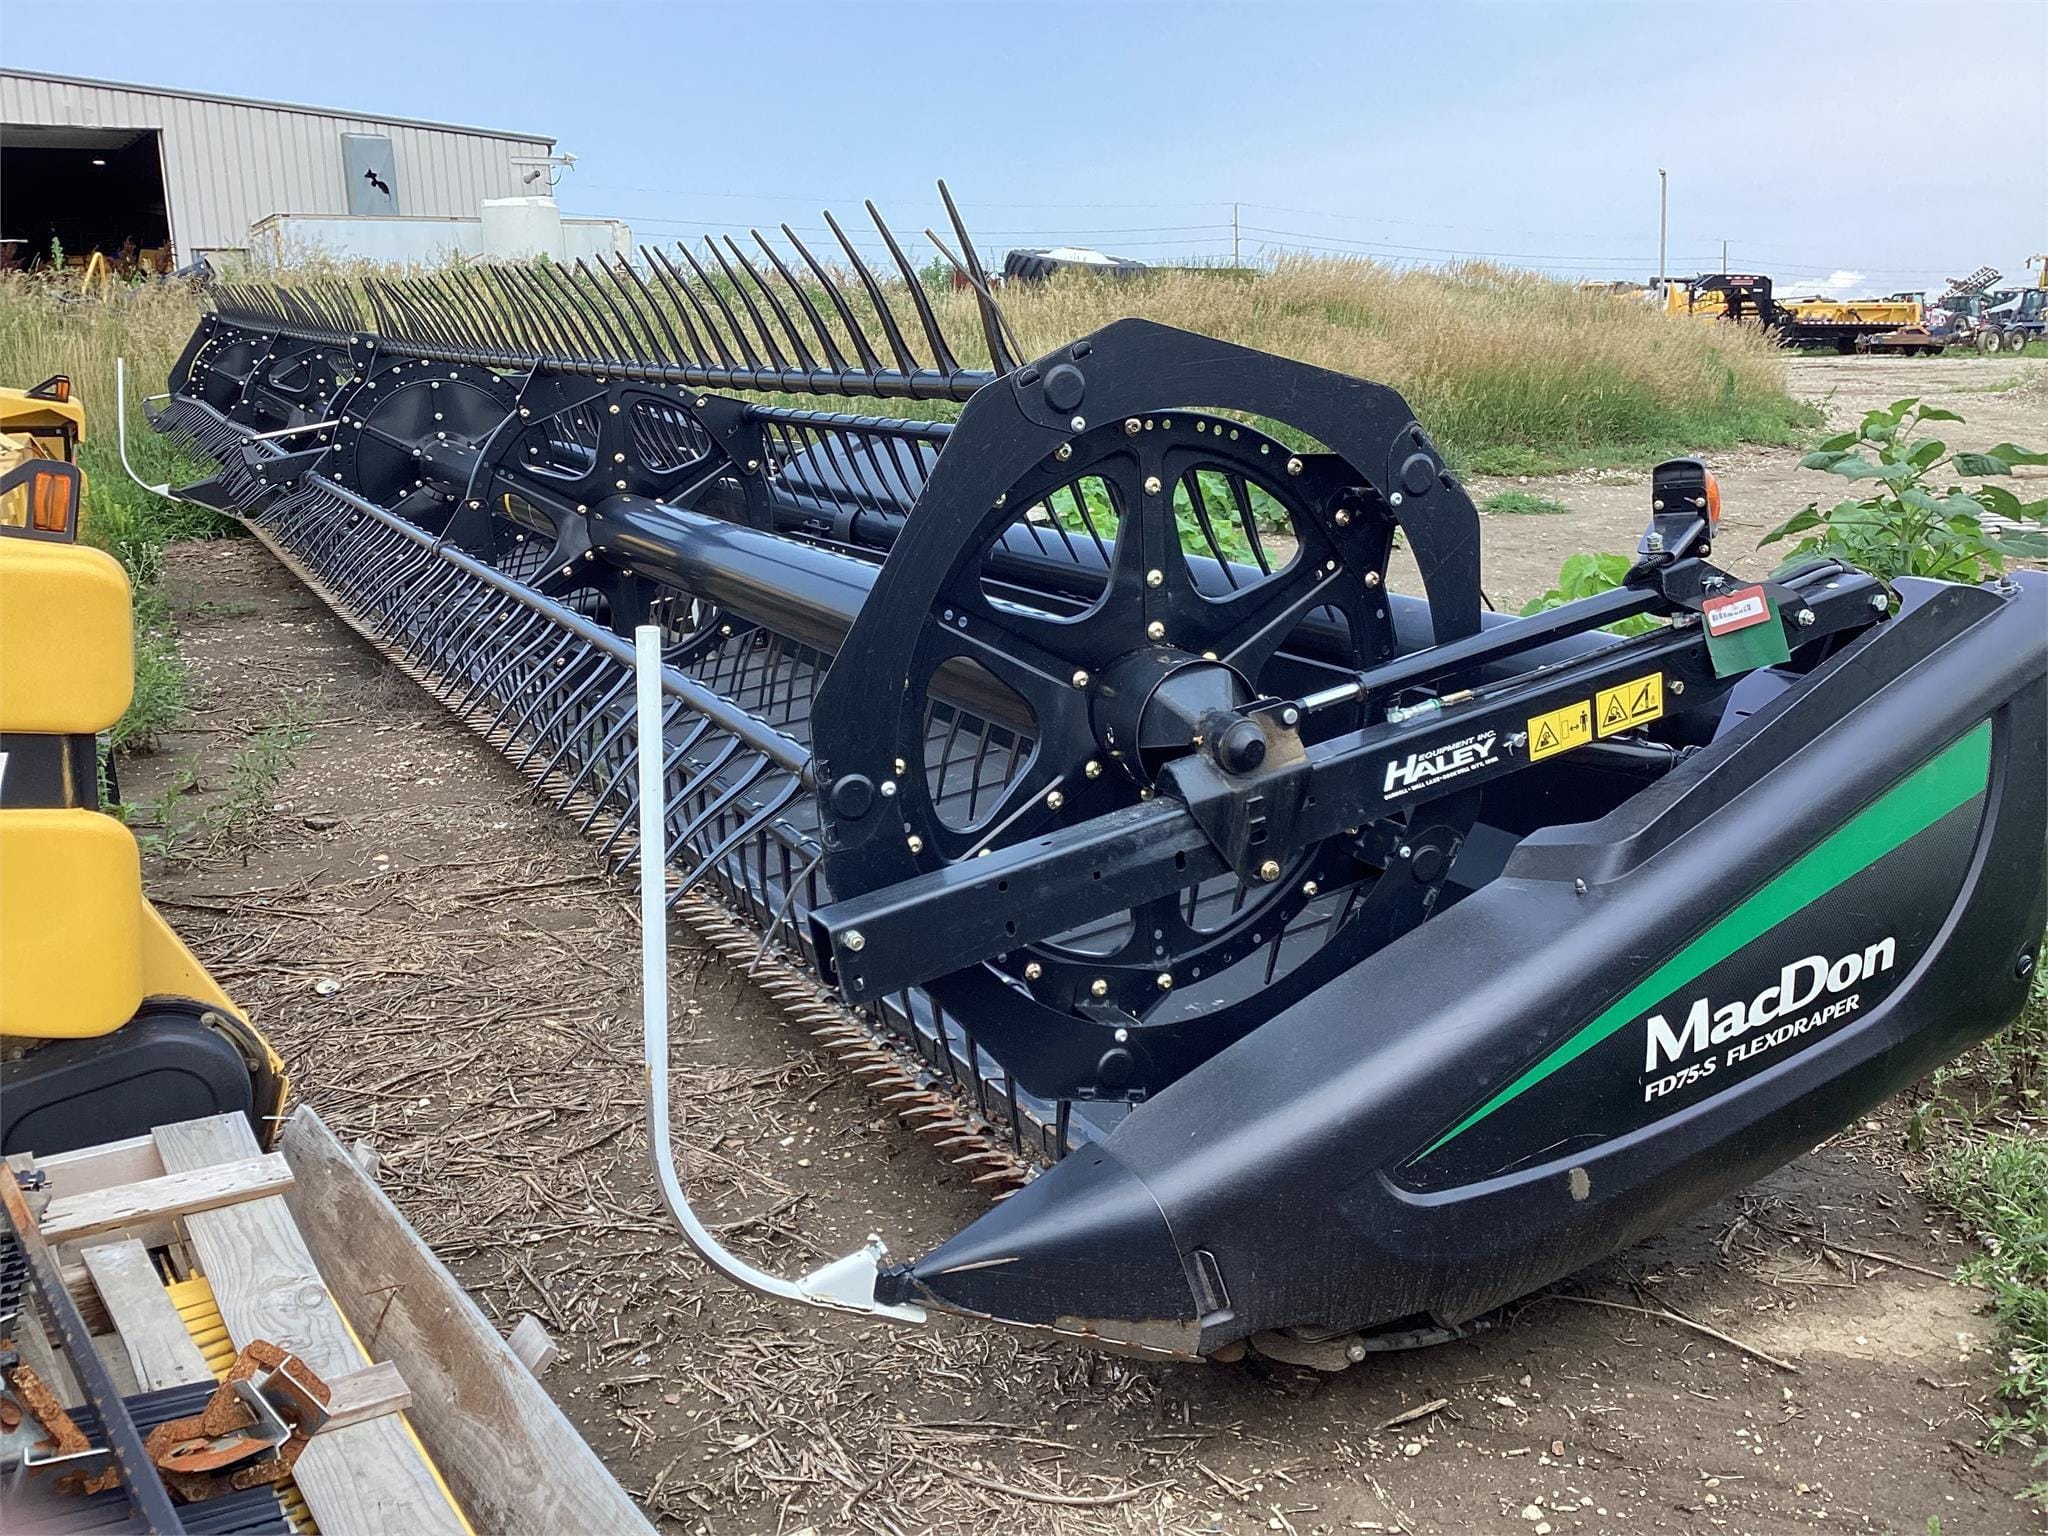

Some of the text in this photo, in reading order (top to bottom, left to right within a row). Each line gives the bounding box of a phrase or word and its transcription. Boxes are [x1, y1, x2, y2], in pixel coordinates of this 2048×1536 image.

[1383, 737, 1497, 792] HALEY
[1418, 730, 1497, 761] EQUIPMENT INC.
[1645, 936, 1896, 1073] MacDon
[1644, 994, 1860, 1103] FD75-S FLEXDRAPER
